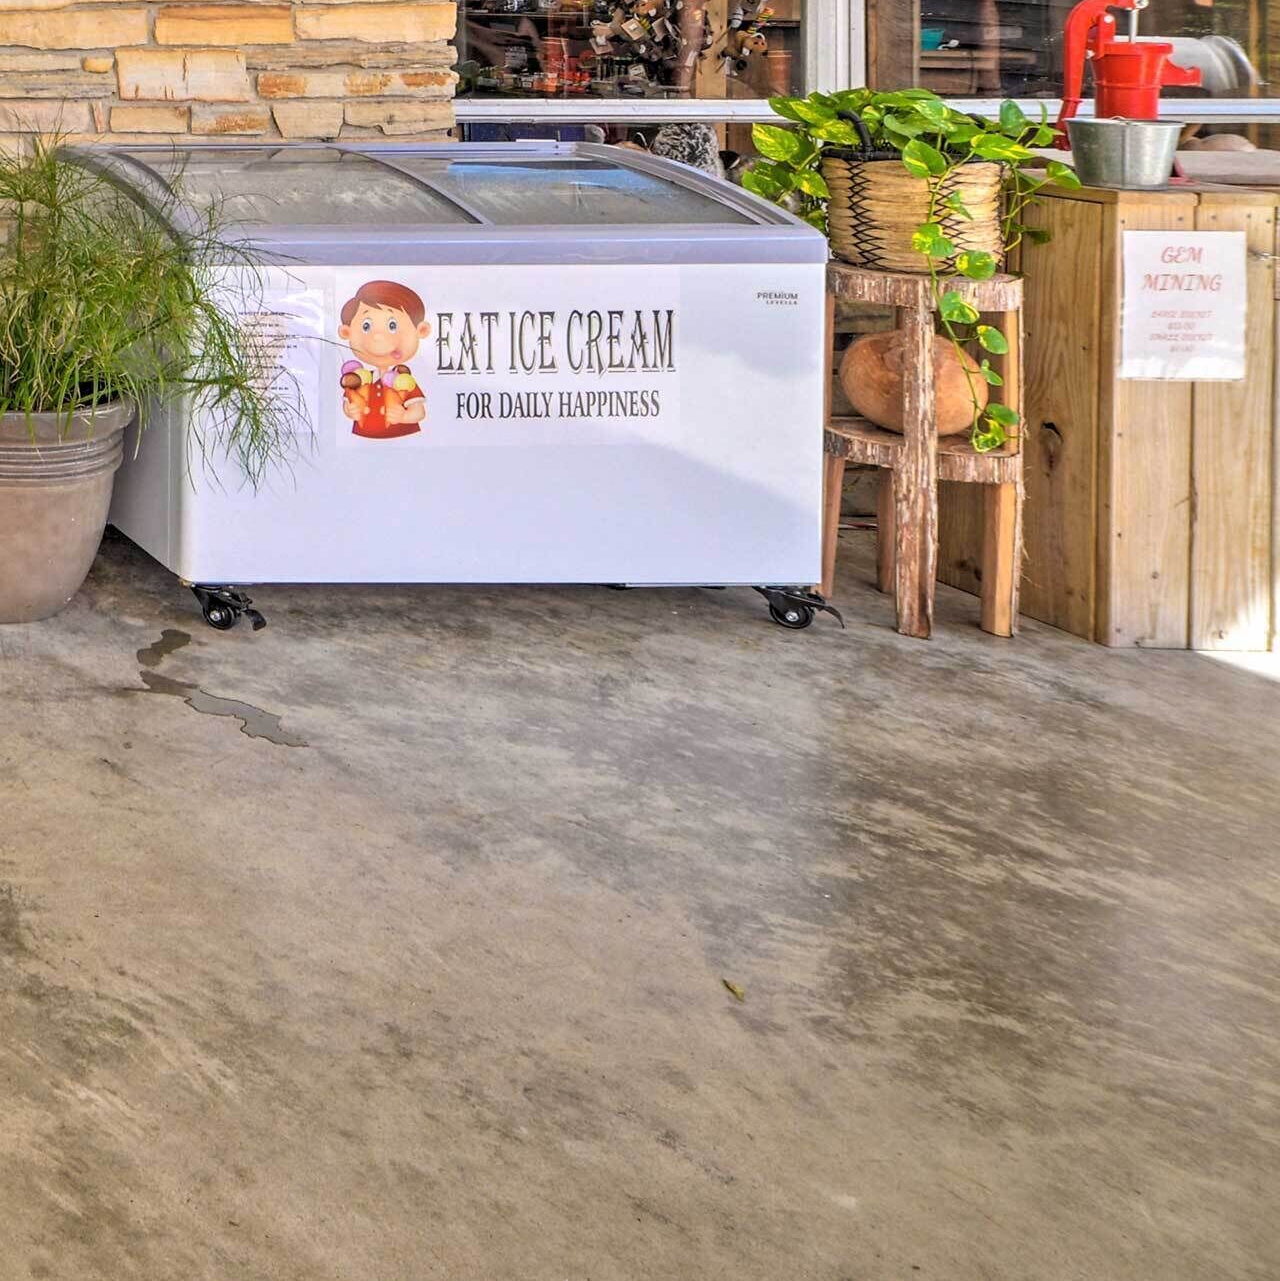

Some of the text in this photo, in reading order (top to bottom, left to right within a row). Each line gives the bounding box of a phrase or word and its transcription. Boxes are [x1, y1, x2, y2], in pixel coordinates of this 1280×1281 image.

[1161, 246, 1204, 264] GEM
[1142, 273, 1224, 292] MINING
[757, 291, 798, 300] PREMIUM
[436, 308, 678, 378] EAT ICE CREAM
[456, 389, 661, 420] FOR DAILY HAPPINESS
